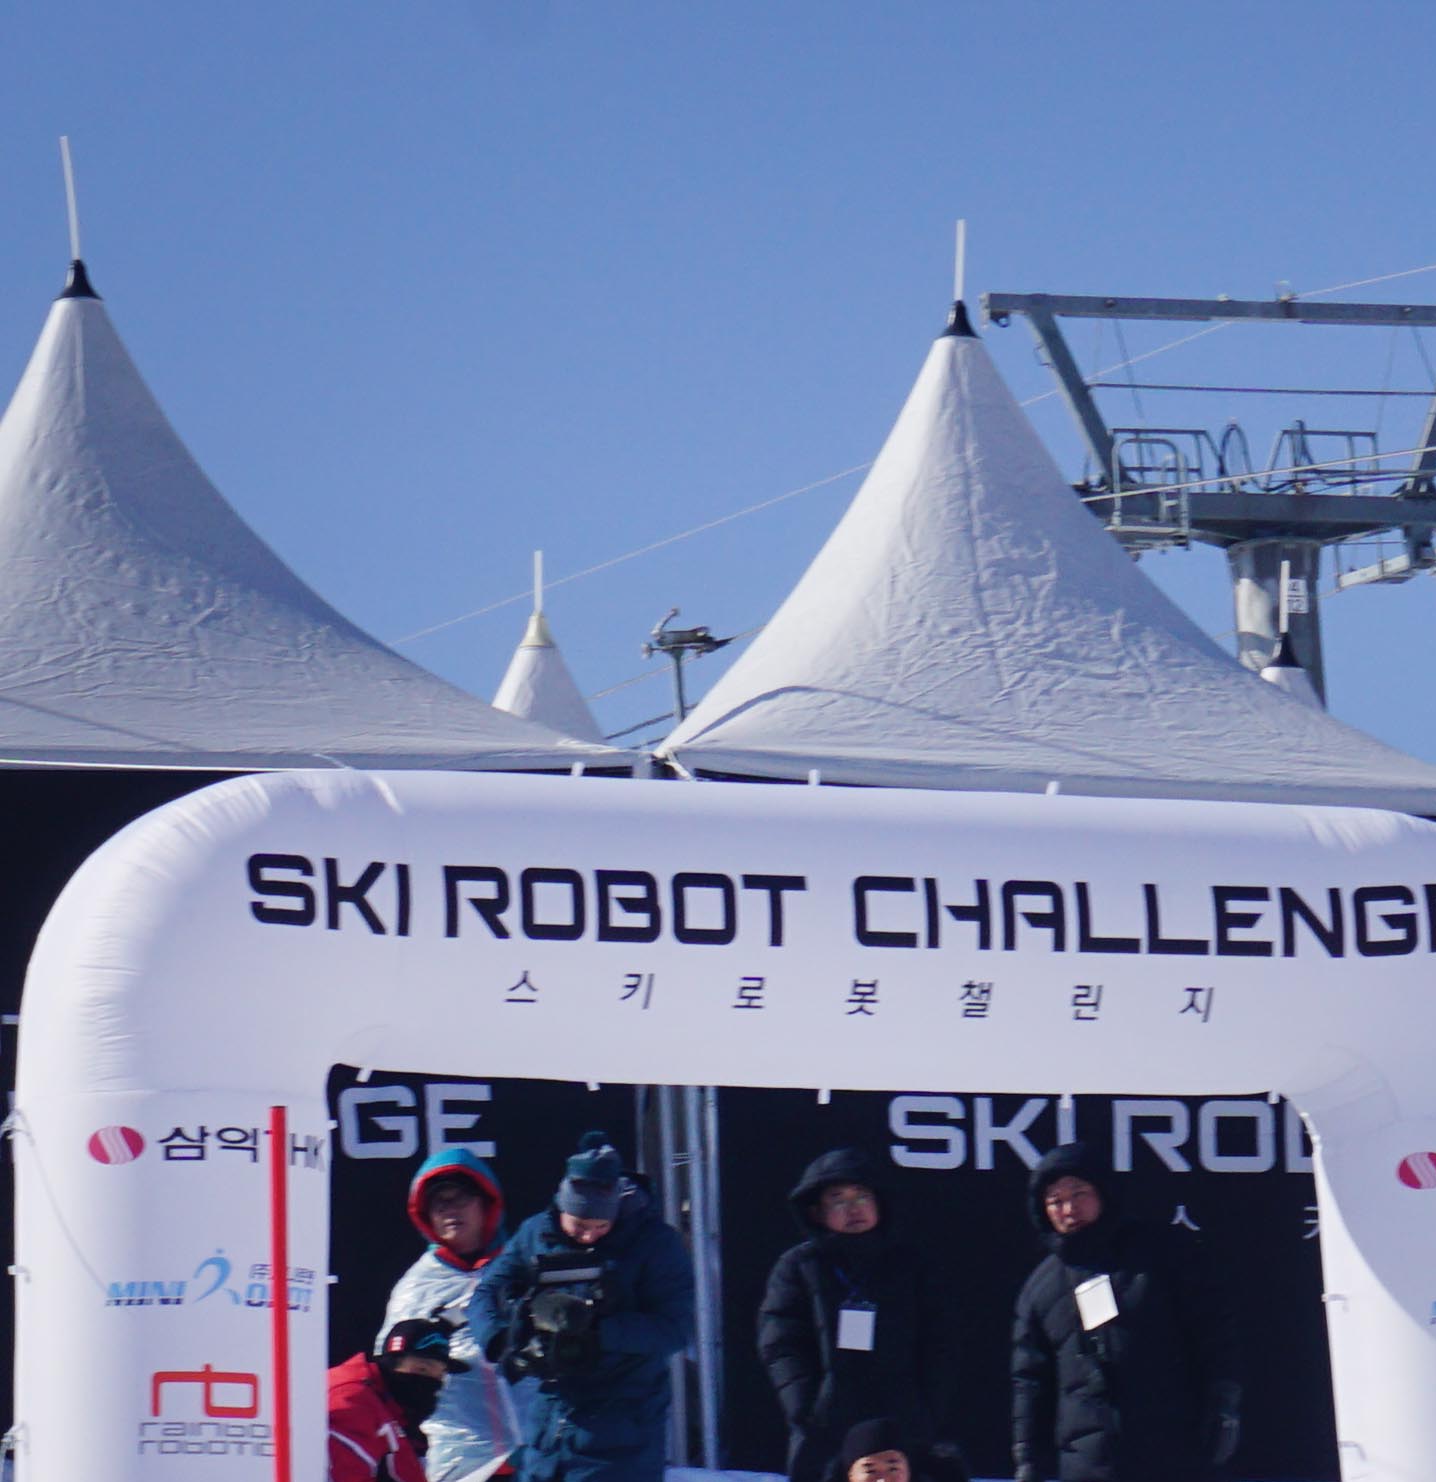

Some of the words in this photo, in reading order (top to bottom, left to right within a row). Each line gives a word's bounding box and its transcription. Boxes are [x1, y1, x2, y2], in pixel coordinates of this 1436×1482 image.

[246, 853, 411, 937] SKI
[442, 864, 807, 947] ROBOT
[157, 1125, 325, 1172] 삼익HK
[888, 1096, 1077, 1171] SKI
[105, 1280, 187, 1306] MINI
[139, 1421, 272, 1438] rainbo
